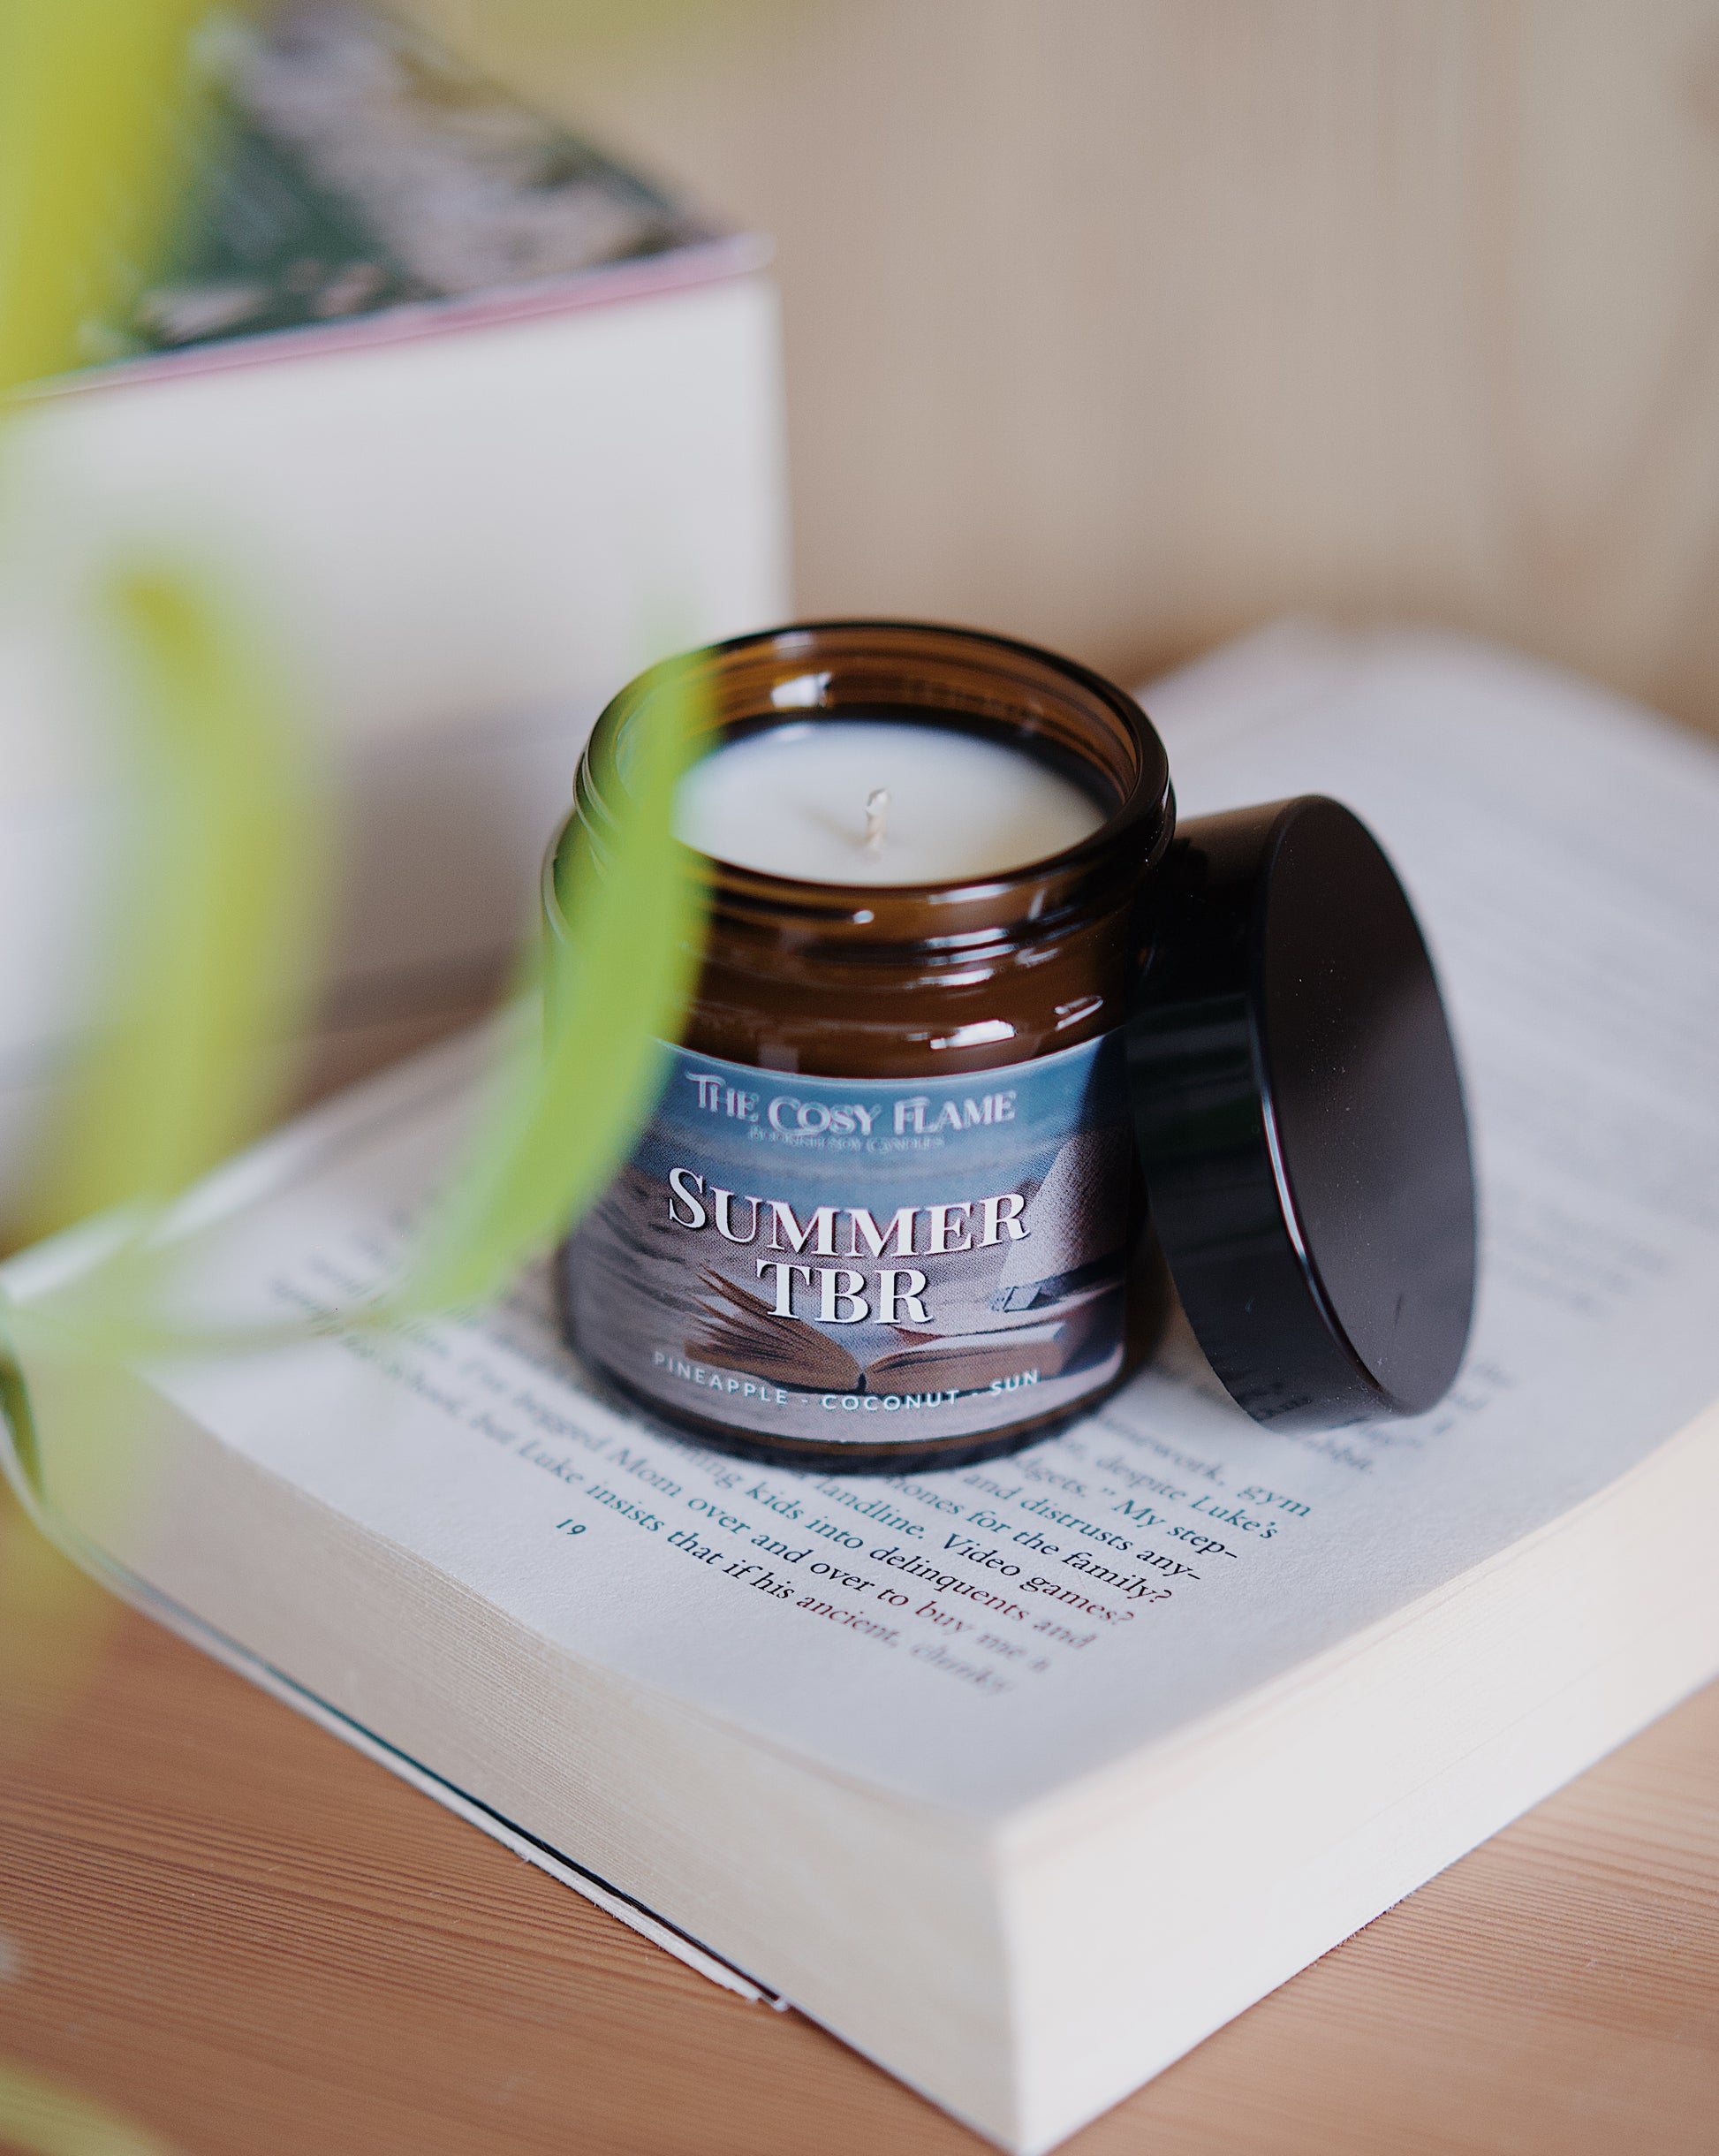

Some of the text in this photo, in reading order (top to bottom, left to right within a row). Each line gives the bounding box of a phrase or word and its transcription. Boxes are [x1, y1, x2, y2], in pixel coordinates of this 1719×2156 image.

[685, 1070, 1018, 1136] THE COSY FLAME
[668, 1167, 1031, 1258] SUMMER
[756, 1258, 934, 1325] TBR
[653, 1351, 789, 1405] PINEAPPLE
[821, 1388, 959, 1411] COCONUT
[988, 1369, 1041, 1397] SUN
[1095, 1457, 1187, 1501] despite
[1237, 1484, 1313, 1518] gym
[517, 1439, 584, 1484] Luke
[585, 1480, 665, 1532] insists
[666, 1530, 724, 1565] that
[721, 1559, 763, 1580] if
[749, 1571, 796, 1600] his
[796, 1595, 901, 1647] ancient,
[556, 1518, 587, 1536] 19
[608, 1446, 683, 1498] Mom
[686, 1498, 752, 1535] over
[750, 1534, 814, 1564] and
[809, 1561, 876, 1592] over
[876, 1588, 910, 1606] to
[914, 1600, 973, 1635] buy
[745, 1481, 805, 1521] kids
[805, 1515, 865, 1549] into
[868, 1546, 1030, 1621] delinquents
[1032, 1617, 1098, 1651] and
[814, 1476, 1135, 1625] landline. Video games?
[963, 1473, 1201, 1581] and distrusts any-
[966, 1509, 1013, 1534] for
[1011, 1531, 1061, 1556] the
[1061, 1551, 1173, 1604] family?
[1111, 1499, 1167, 1529] My
[1166, 1524, 1238, 1560] step-
